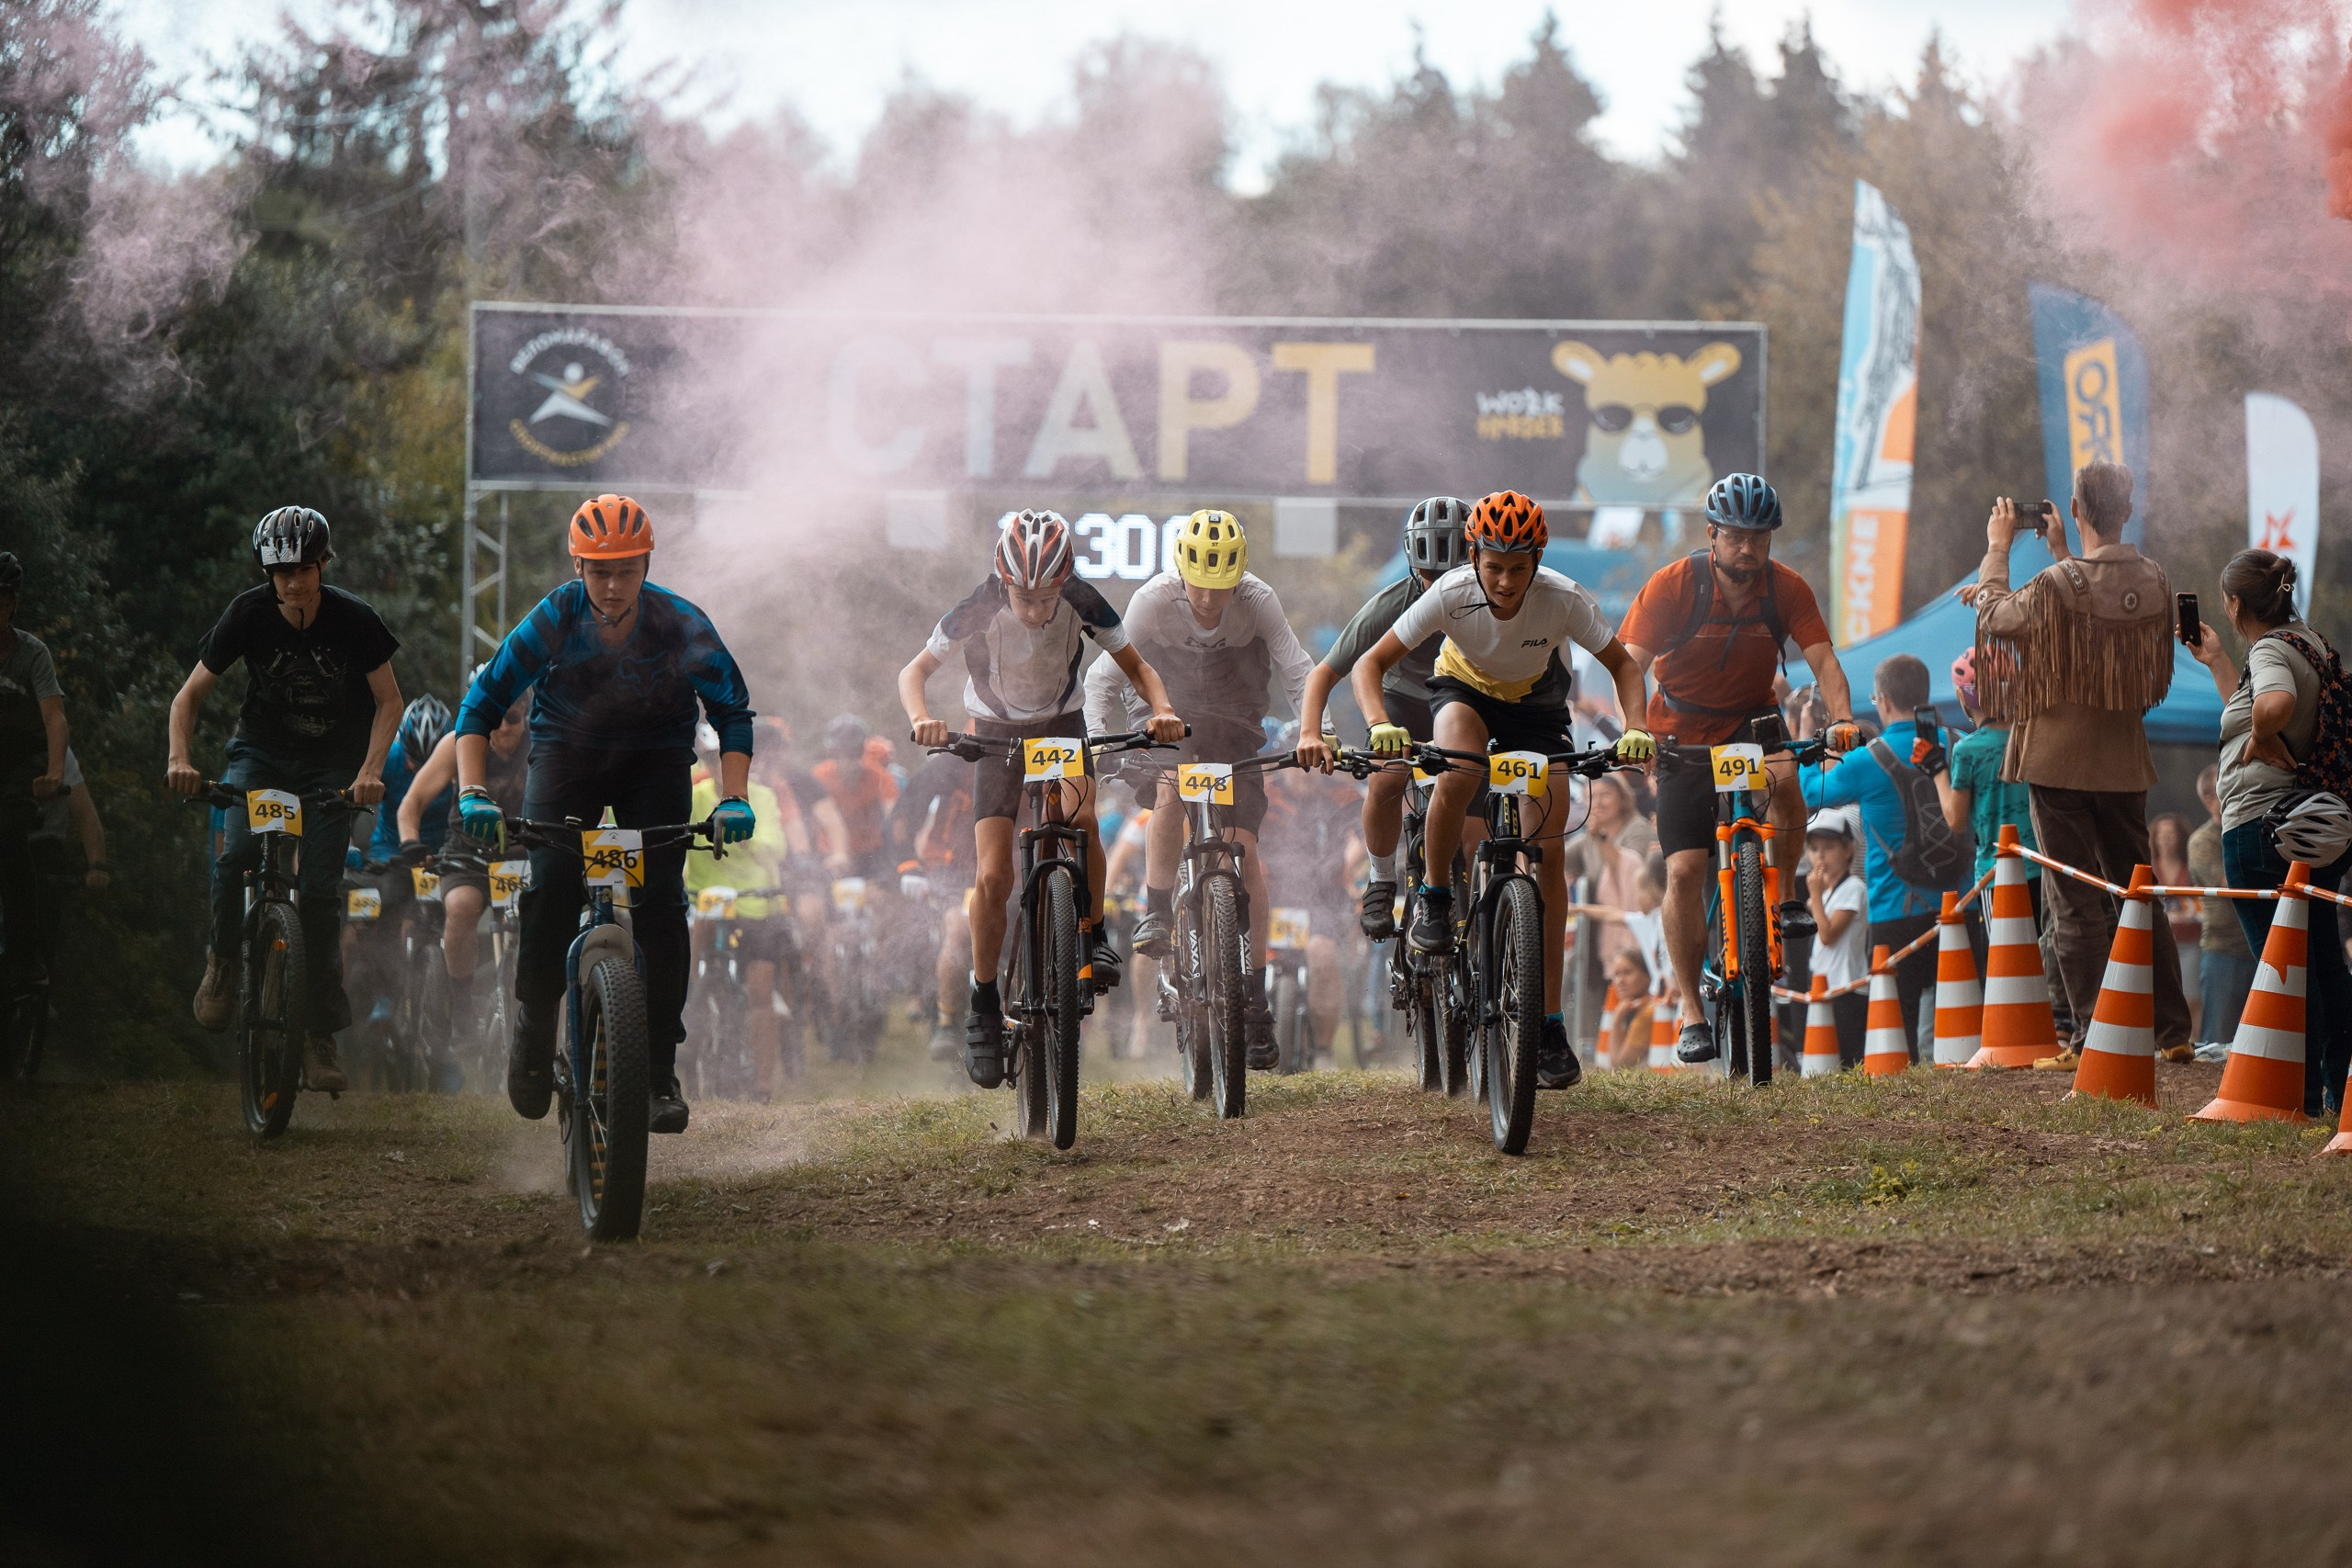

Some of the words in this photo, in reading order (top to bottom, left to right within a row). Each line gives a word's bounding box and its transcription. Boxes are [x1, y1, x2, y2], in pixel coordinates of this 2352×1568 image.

[828, 339, 1376, 485] СТАРТ
[1521, 637, 1548, 649] FILA
[1032, 749, 1076, 766] 442
[1497, 760, 1542, 780] 461
[1719, 757, 1759, 777] 491
[1185, 775, 1227, 792] 448
[254, 803, 296, 820] 485
[592, 849, 638, 869] 486
